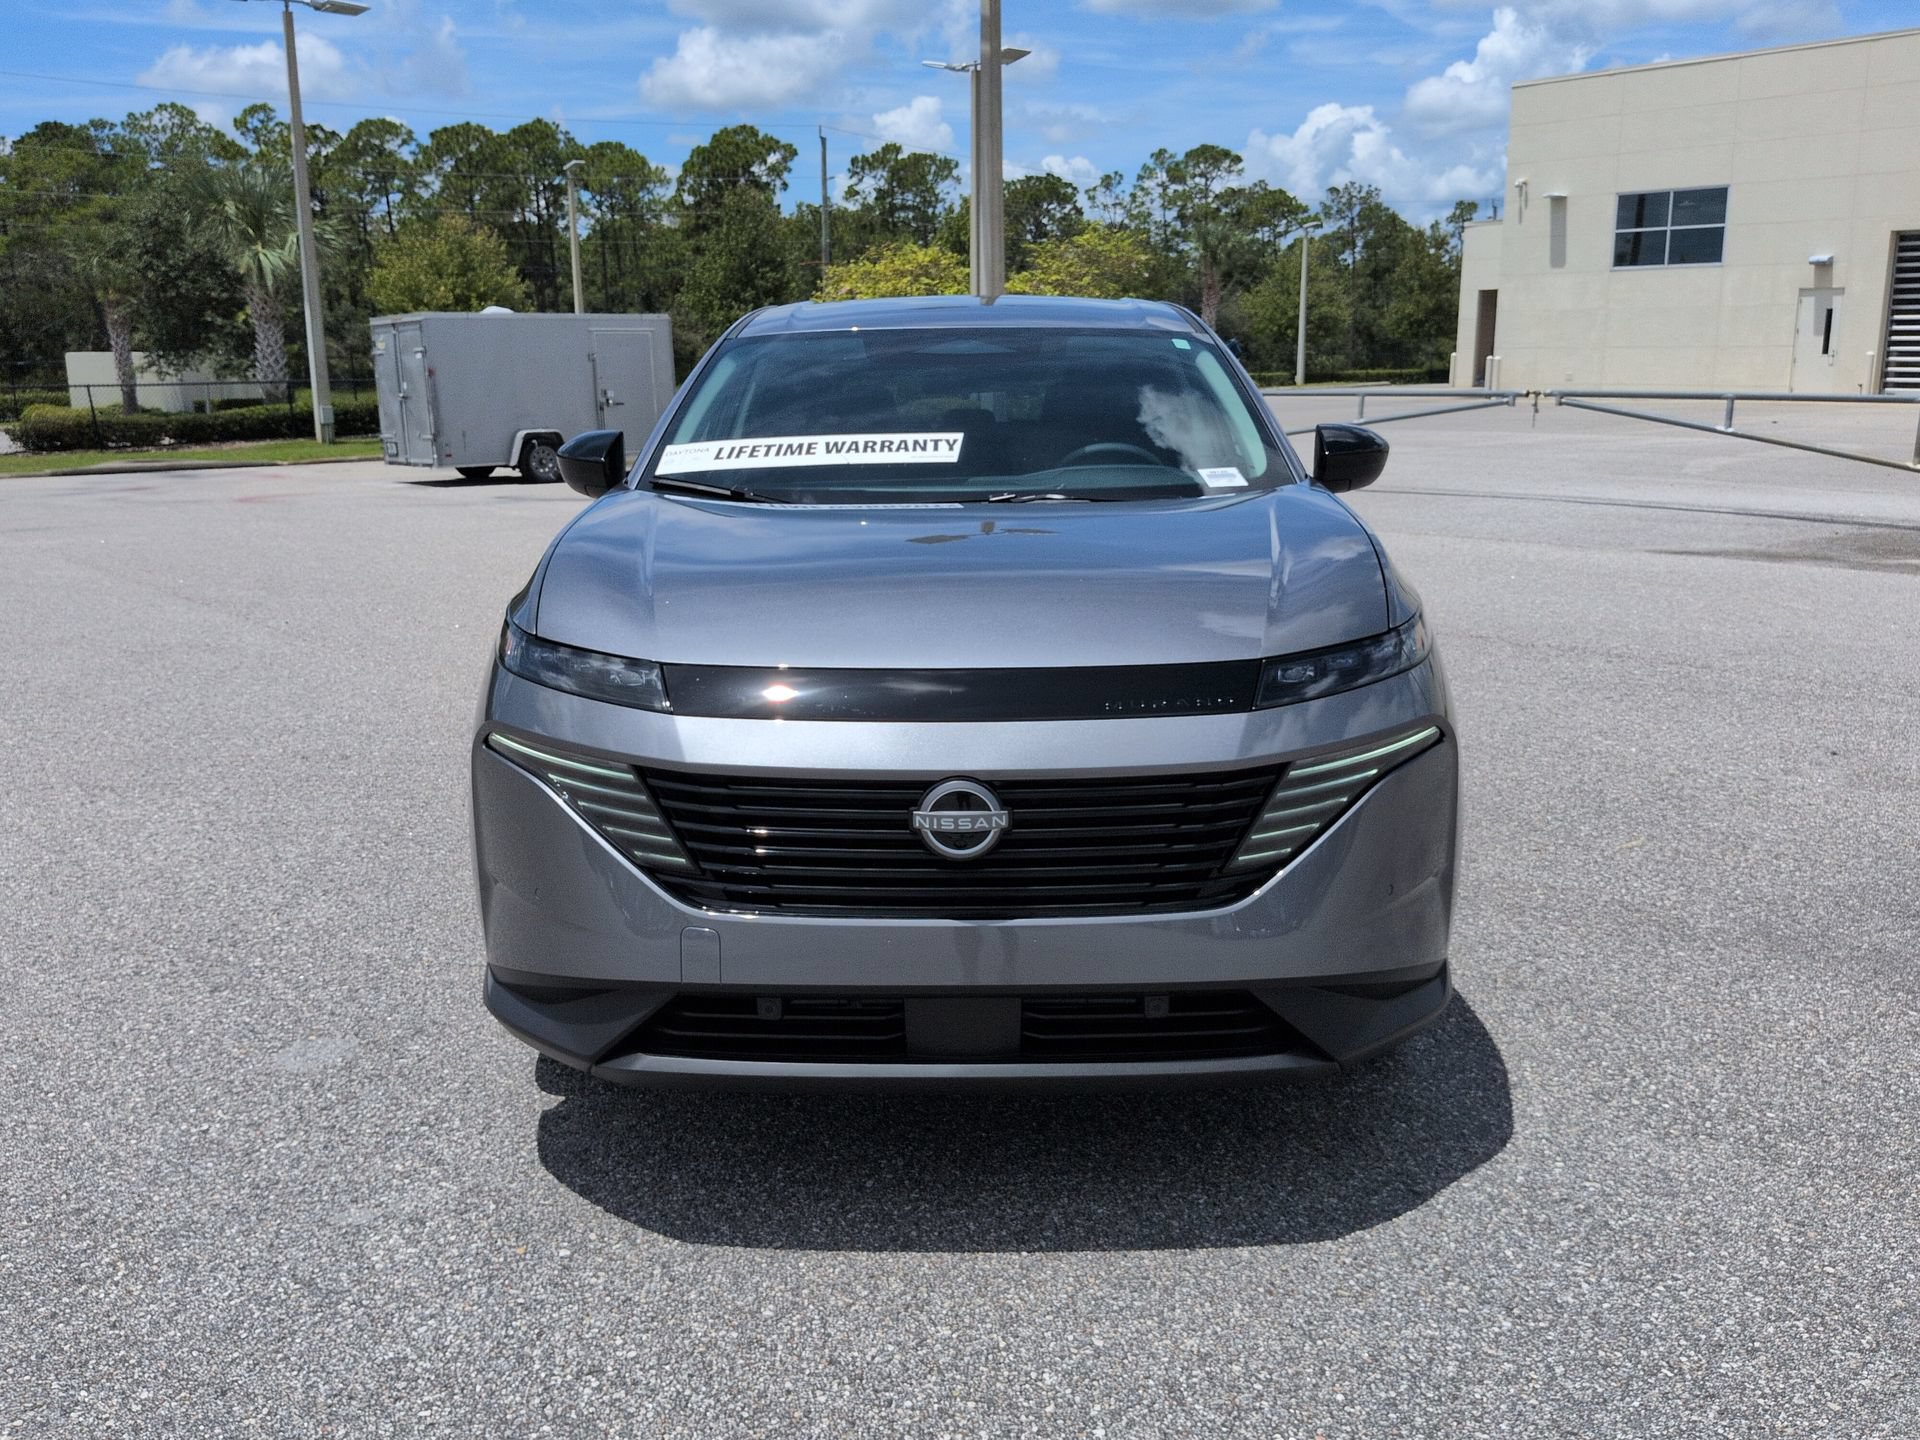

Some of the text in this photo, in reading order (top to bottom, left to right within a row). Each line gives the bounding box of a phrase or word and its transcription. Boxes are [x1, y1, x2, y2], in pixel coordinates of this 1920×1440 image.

[713, 439, 959, 460] LIFETIME WARRANTY
[915, 815, 1006, 829] NISSAN
